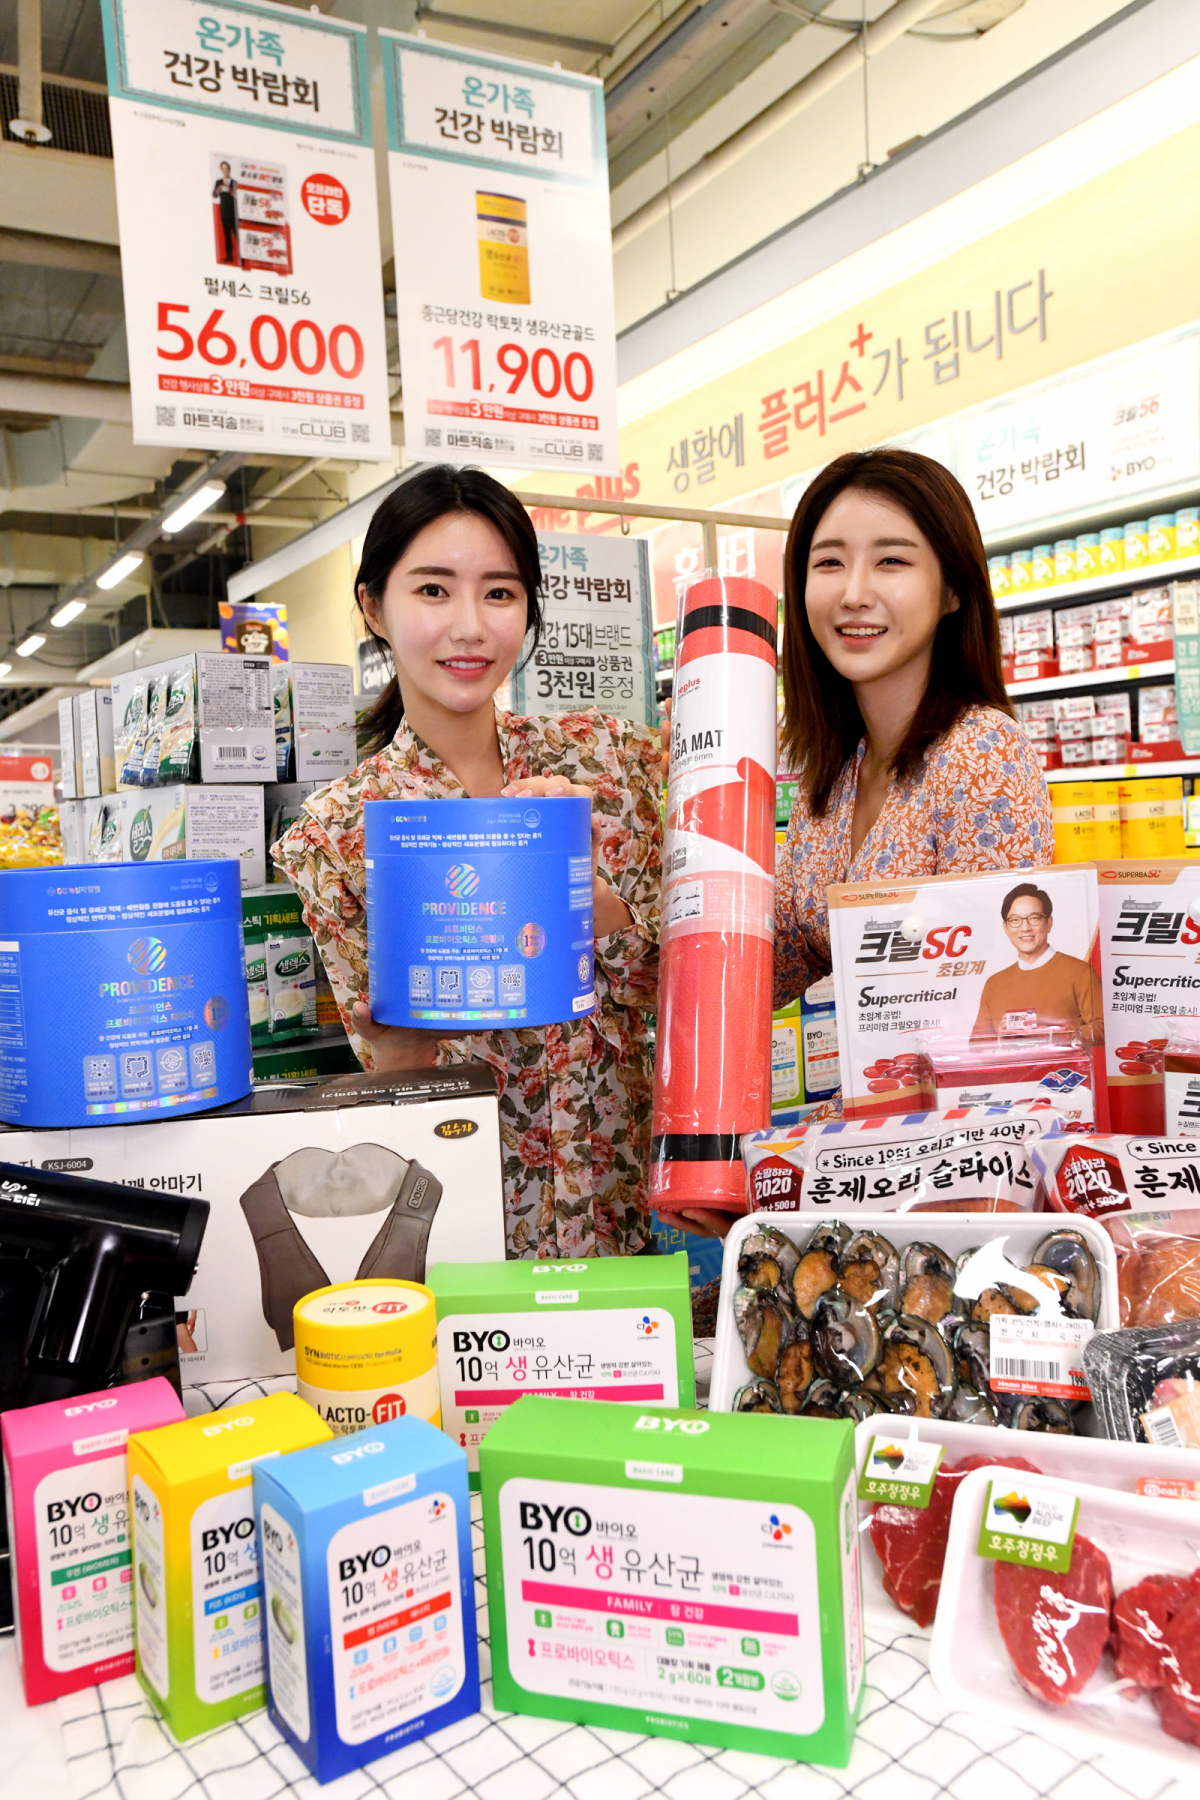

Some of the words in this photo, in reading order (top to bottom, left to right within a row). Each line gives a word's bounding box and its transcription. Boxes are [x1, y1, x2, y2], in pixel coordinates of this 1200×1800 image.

[196, 16, 285, 67] 온가족
[164, 50, 224, 93] 건강
[231, 65, 319, 112] 박람회
[461, 76, 535, 120] 온가족
[434, 107, 484, 144] 건강
[490, 119, 563, 160] 박람회
[307, 196, 344, 219] 단독
[204, 277, 253, 299] 펄세스
[259, 285, 311, 306] 크릴56
[486, 313, 522, 333] 락토핏
[526, 321, 596, 342] 생유산균골드
[157, 301, 364, 380] 56,000
[433, 335, 594, 402] 11,900
[667, 413, 744, 494] 생활에
[923, 269, 1053, 385] 됩니다
[183, 412, 238, 431] 마트직송
[300, 423, 346, 439] CLUB
[447, 434, 493, 450] 마트직송
[545, 442, 583, 457] CLUB
[978, 416, 1042, 462] 온가족
[977, 465, 1016, 500] 건강
[1021, 441, 1086, 486] 박람회
[1126, 456, 1156, 476] BYO
[573, 577, 632, 603] 박람회
[562, 622, 593, 649] 15대
[594, 624, 633, 650] 브랜드
[596, 655, 633, 672] 상품권
[537, 670, 595, 699] 3천원
[598, 676, 634, 699] 증정
[691, 729, 724, 752] MAT
[694, 752, 713, 762] 6mm
[263, 912, 299, 926] 기획세트
[422, 901, 507, 916] PROVIDENCE
[425, 935, 478, 944] 프로바이오틱스
[444, 925, 484, 933] 프로비던스
[278, 955, 310, 975] 셀렉스
[936, 960, 987, 978] 초임계
[99, 974, 195, 998] PROVIDENCE
[857, 985, 958, 1009] Supercritical
[1112, 991, 1137, 1002] 초임계
[1137, 992, 1157, 1002] 공법!
[858, 1011, 882, 1022] 초임계
[883, 1010, 901, 1020] 공법!
[1111, 1002, 1144, 1014] 프리미엄
[1145, 1003, 1178, 1015] 크릴오일
[1178, 1005, 1198, 1016] 출시!
[807, 1031, 822, 1040] BYO
[858, 1021, 889, 1033] 프리미엄
[889, 1020, 921, 1031] 크릴오일
[922, 1018, 941, 1029] 출시!
[441, 1122, 473, 1136] 김수자
[833, 1155, 874, 1169] Since
[989, 1123, 1025, 1139] 40년
[1148, 1142, 1197, 1154] Since
[48, 1160, 87, 1170] KSJ-6004
[755, 1167, 793, 1180] 쇼핑하라
[1063, 1157, 1106, 1180] 쇼핑하라
[755, 1177, 792, 1201] 2020
[807, 1167, 921, 1204] 훈제오리
[931, 1151, 1035, 1189] 슬라이스
[1066, 1169, 1112, 1200] 2020
[532, 1263, 588, 1274] BYO
[453, 1330, 511, 1352] BYO
[513, 1337, 546, 1349] 바이오
[374, 1348, 402, 1358] formula
[456, 1356, 499, 1382] 10억
[569, 1390, 578, 1400] 장
[579, 1390, 596, 1400] 건강
[1022, 1382, 1037, 1390] plus
[64, 1399, 118, 1418] BYO
[202, 1416, 255, 1438] BYO
[634, 1415, 711, 1435] BYO
[331, 1442, 385, 1465] BYO
[866, 1481, 921, 1501] 호주청정우
[1143, 1484, 1178, 1498] meat
[47, 1492, 101, 1523] BYO
[519, 1501, 592, 1537] BYO
[595, 1521, 637, 1538] 바이오
[1032, 1517, 1051, 1527] BEEF
[50, 1523, 86, 1548] 10억
[202, 1517, 255, 1552] BYO
[523, 1536, 577, 1575] 10억
[988, 1535, 1059, 1562] 호주청정우
[204, 1551, 239, 1576] 10억
[339, 1544, 391, 1582] BYO
[393, 1539, 422, 1557] 바이오
[341, 1579, 376, 1609] 10억
[606, 1596, 653, 1613] FAMILY
[670, 1603, 681, 1617] 장
[684, 1605, 704, 1620] 건강
[94, 1655, 135, 1674] PROBIOTIC
[541, 1641, 636, 1671] 프로바이오틱스
[645, 1715, 690, 1730] PROBIOTICS
